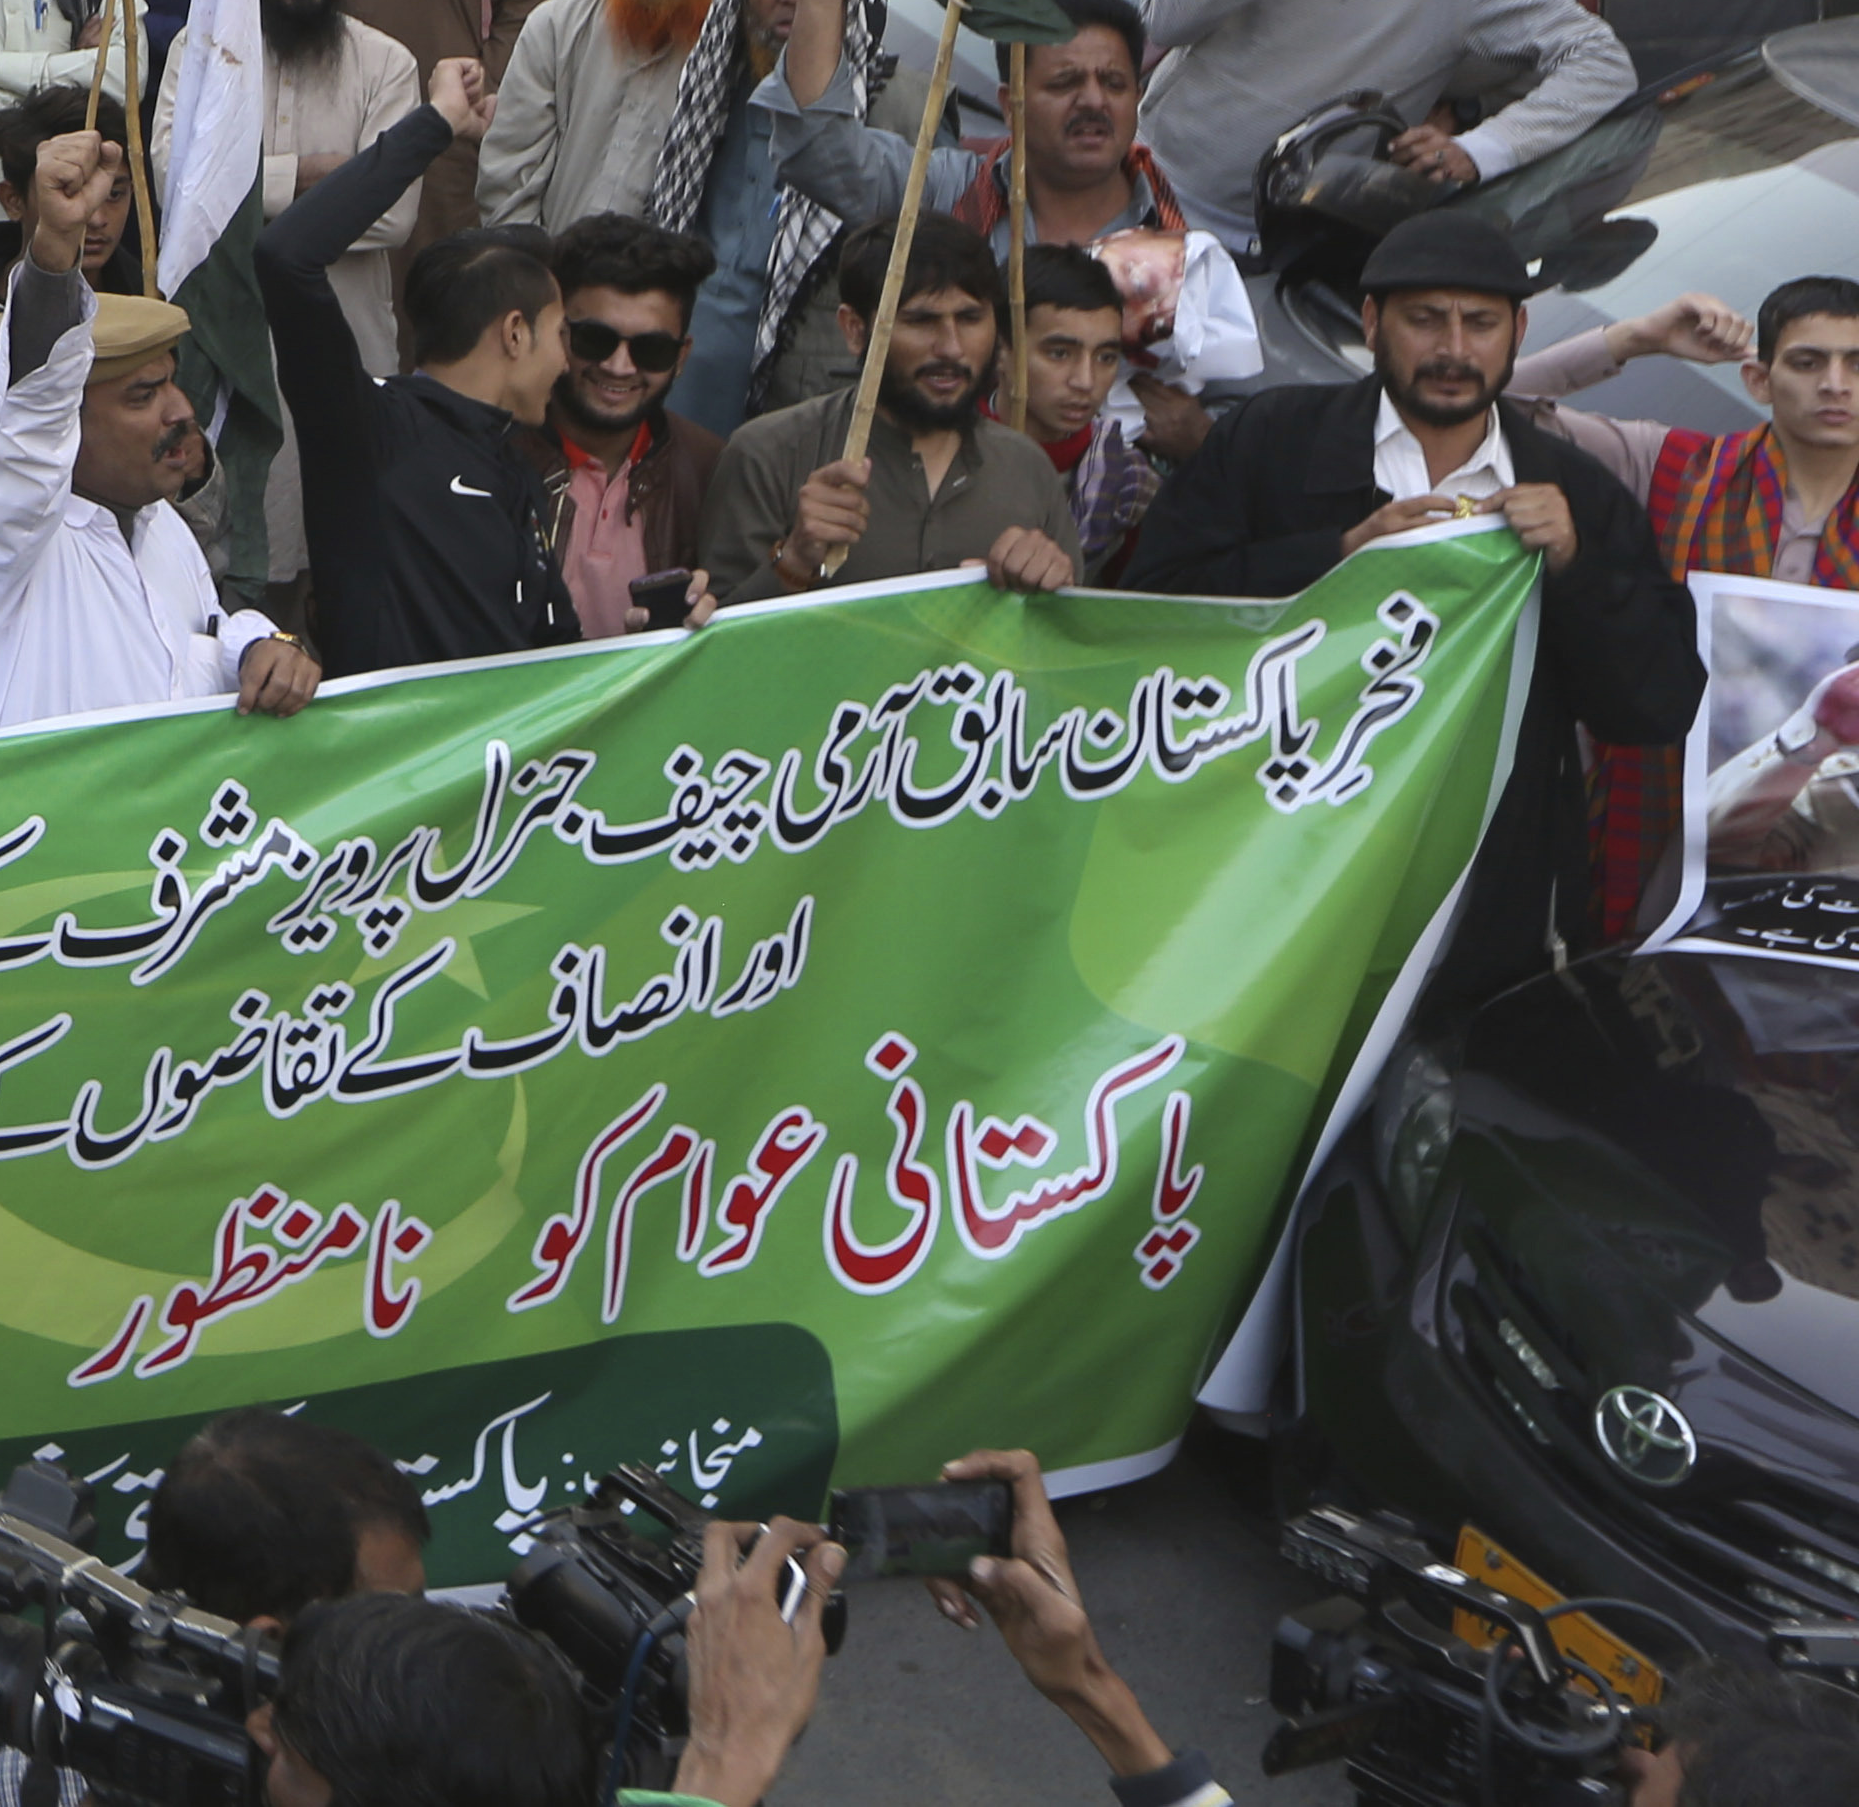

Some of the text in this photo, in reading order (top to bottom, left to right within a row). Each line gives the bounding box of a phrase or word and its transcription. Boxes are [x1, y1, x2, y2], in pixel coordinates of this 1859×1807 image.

[769, 666, 933, 854] آرمی
[891, 662, 1073, 830] سابق
[1060, 617, 1329, 815] پاکستان
[49, 778, 312, 987] مشرف
[269, 824, 441, 956] پرویز
[405, 739, 599, 904] جنرل
[585, 742, 773, 872] چیف
[331, 939, 457, 1102] کے
[455, 906, 725, 1082] انصاف
[710, 896, 814, 1018] اور
[68, 987, 353, 1168] تقاضوں
[824, 1031, 1205, 1295] پاکستانی
[505, 1082, 668, 1313] کو
[602, 1105, 828, 1325] عوام
